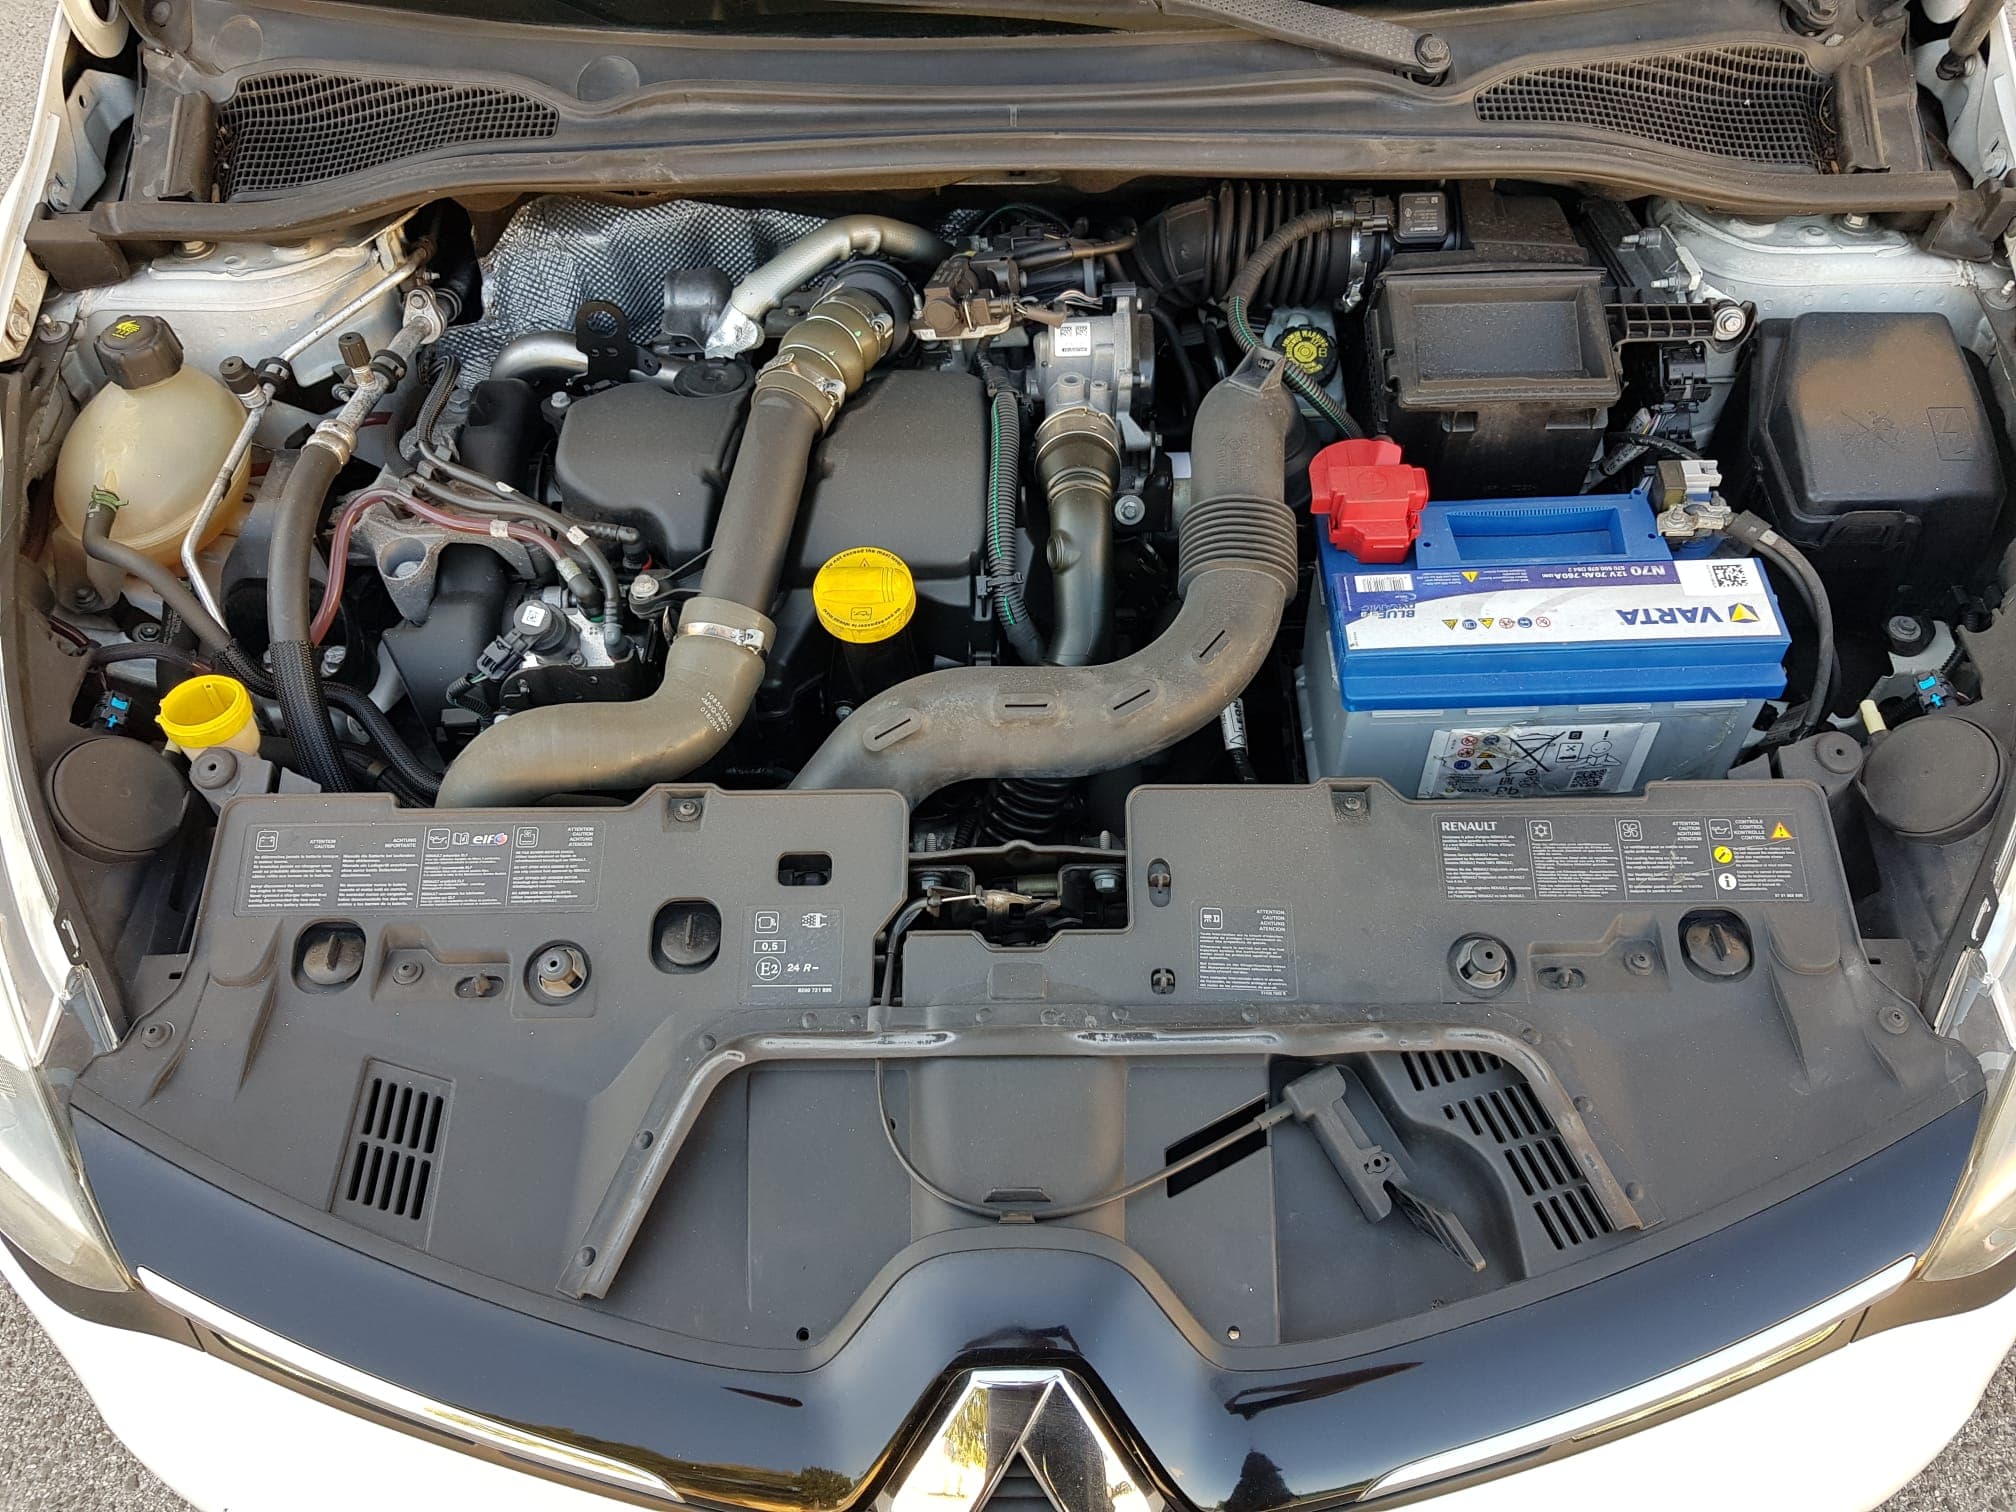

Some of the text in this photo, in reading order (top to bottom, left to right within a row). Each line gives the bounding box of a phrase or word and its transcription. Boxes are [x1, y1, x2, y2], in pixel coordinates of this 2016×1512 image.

[1582, 571, 1608, 579] 70Ah
[1630, 565, 1666, 576] N70
[1378, 609, 1416, 619] BLUE
[1616, 606, 1724, 626] VARTA
[1495, 786, 1520, 796] Pb
[1441, 821, 1498, 831] RENAULT
[472, 833, 496, 845] elf
[760, 962, 778, 975] E2
[787, 963, 800, 972] 24
